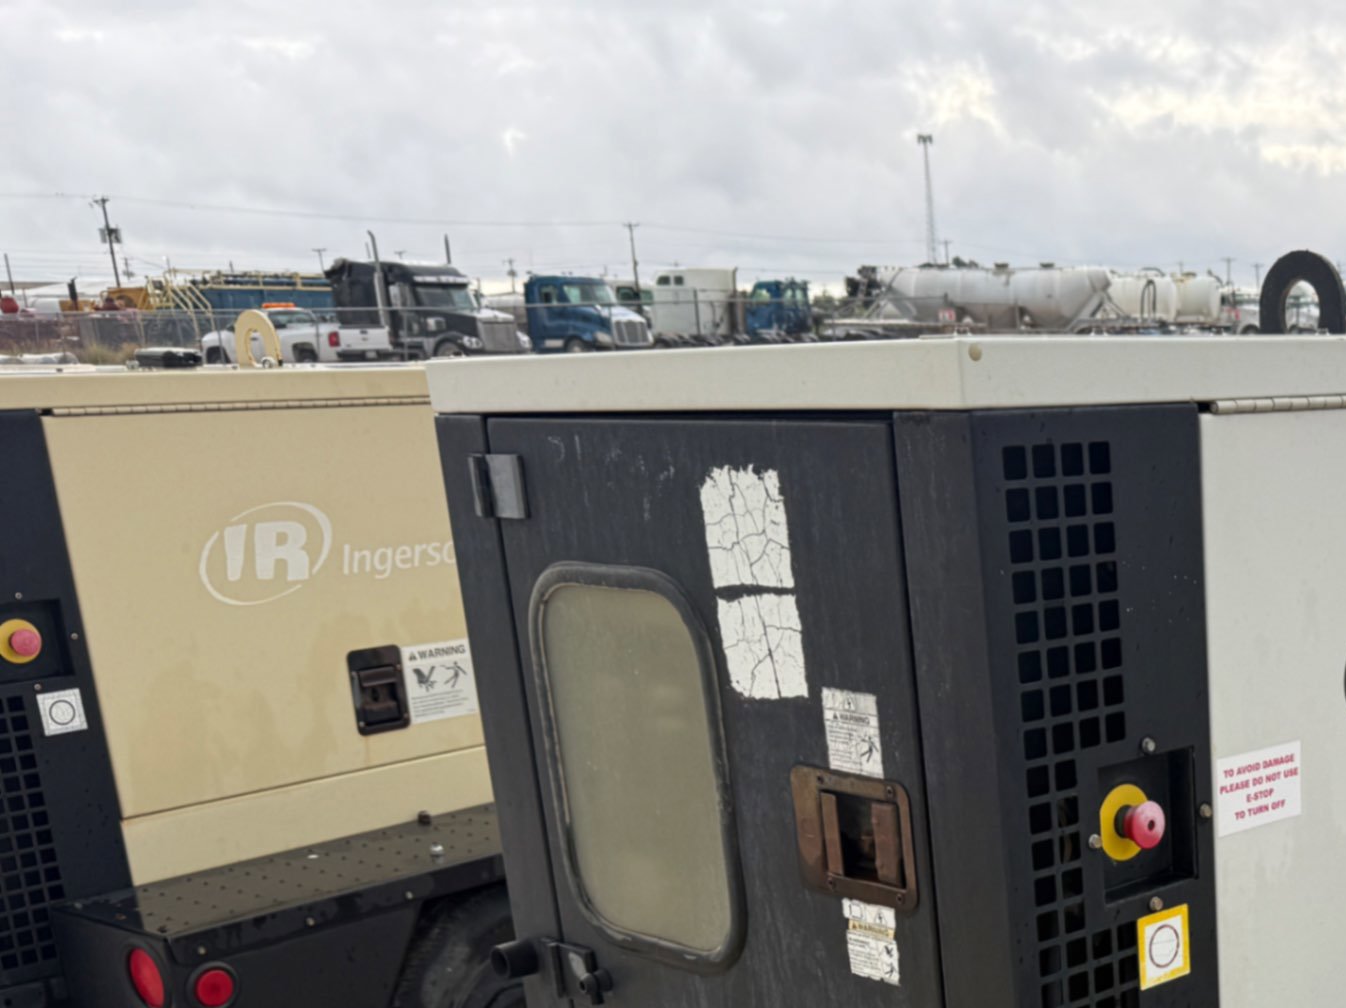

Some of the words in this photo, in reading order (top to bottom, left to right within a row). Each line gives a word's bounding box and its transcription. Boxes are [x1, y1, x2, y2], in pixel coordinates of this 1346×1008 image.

[224, 521, 310, 582] IR
[417, 644, 466, 660] WARNING
[1223, 769, 1235, 779] TO
[1236, 762, 1261, 776] AVOID
[1262, 753, 1295, 770] DAMAGE
[1219, 779, 1250, 795] PLEASE
[1252, 776, 1264, 787] DO
[1265, 771, 1281, 783] NOT
[1283, 767, 1299, 779] USE
[1246, 788, 1275, 803] E-STOP
[1234, 810, 1246, 821] TO
[1248, 804, 1270, 817] TURN
[1271, 799, 1286, 811] OFF
